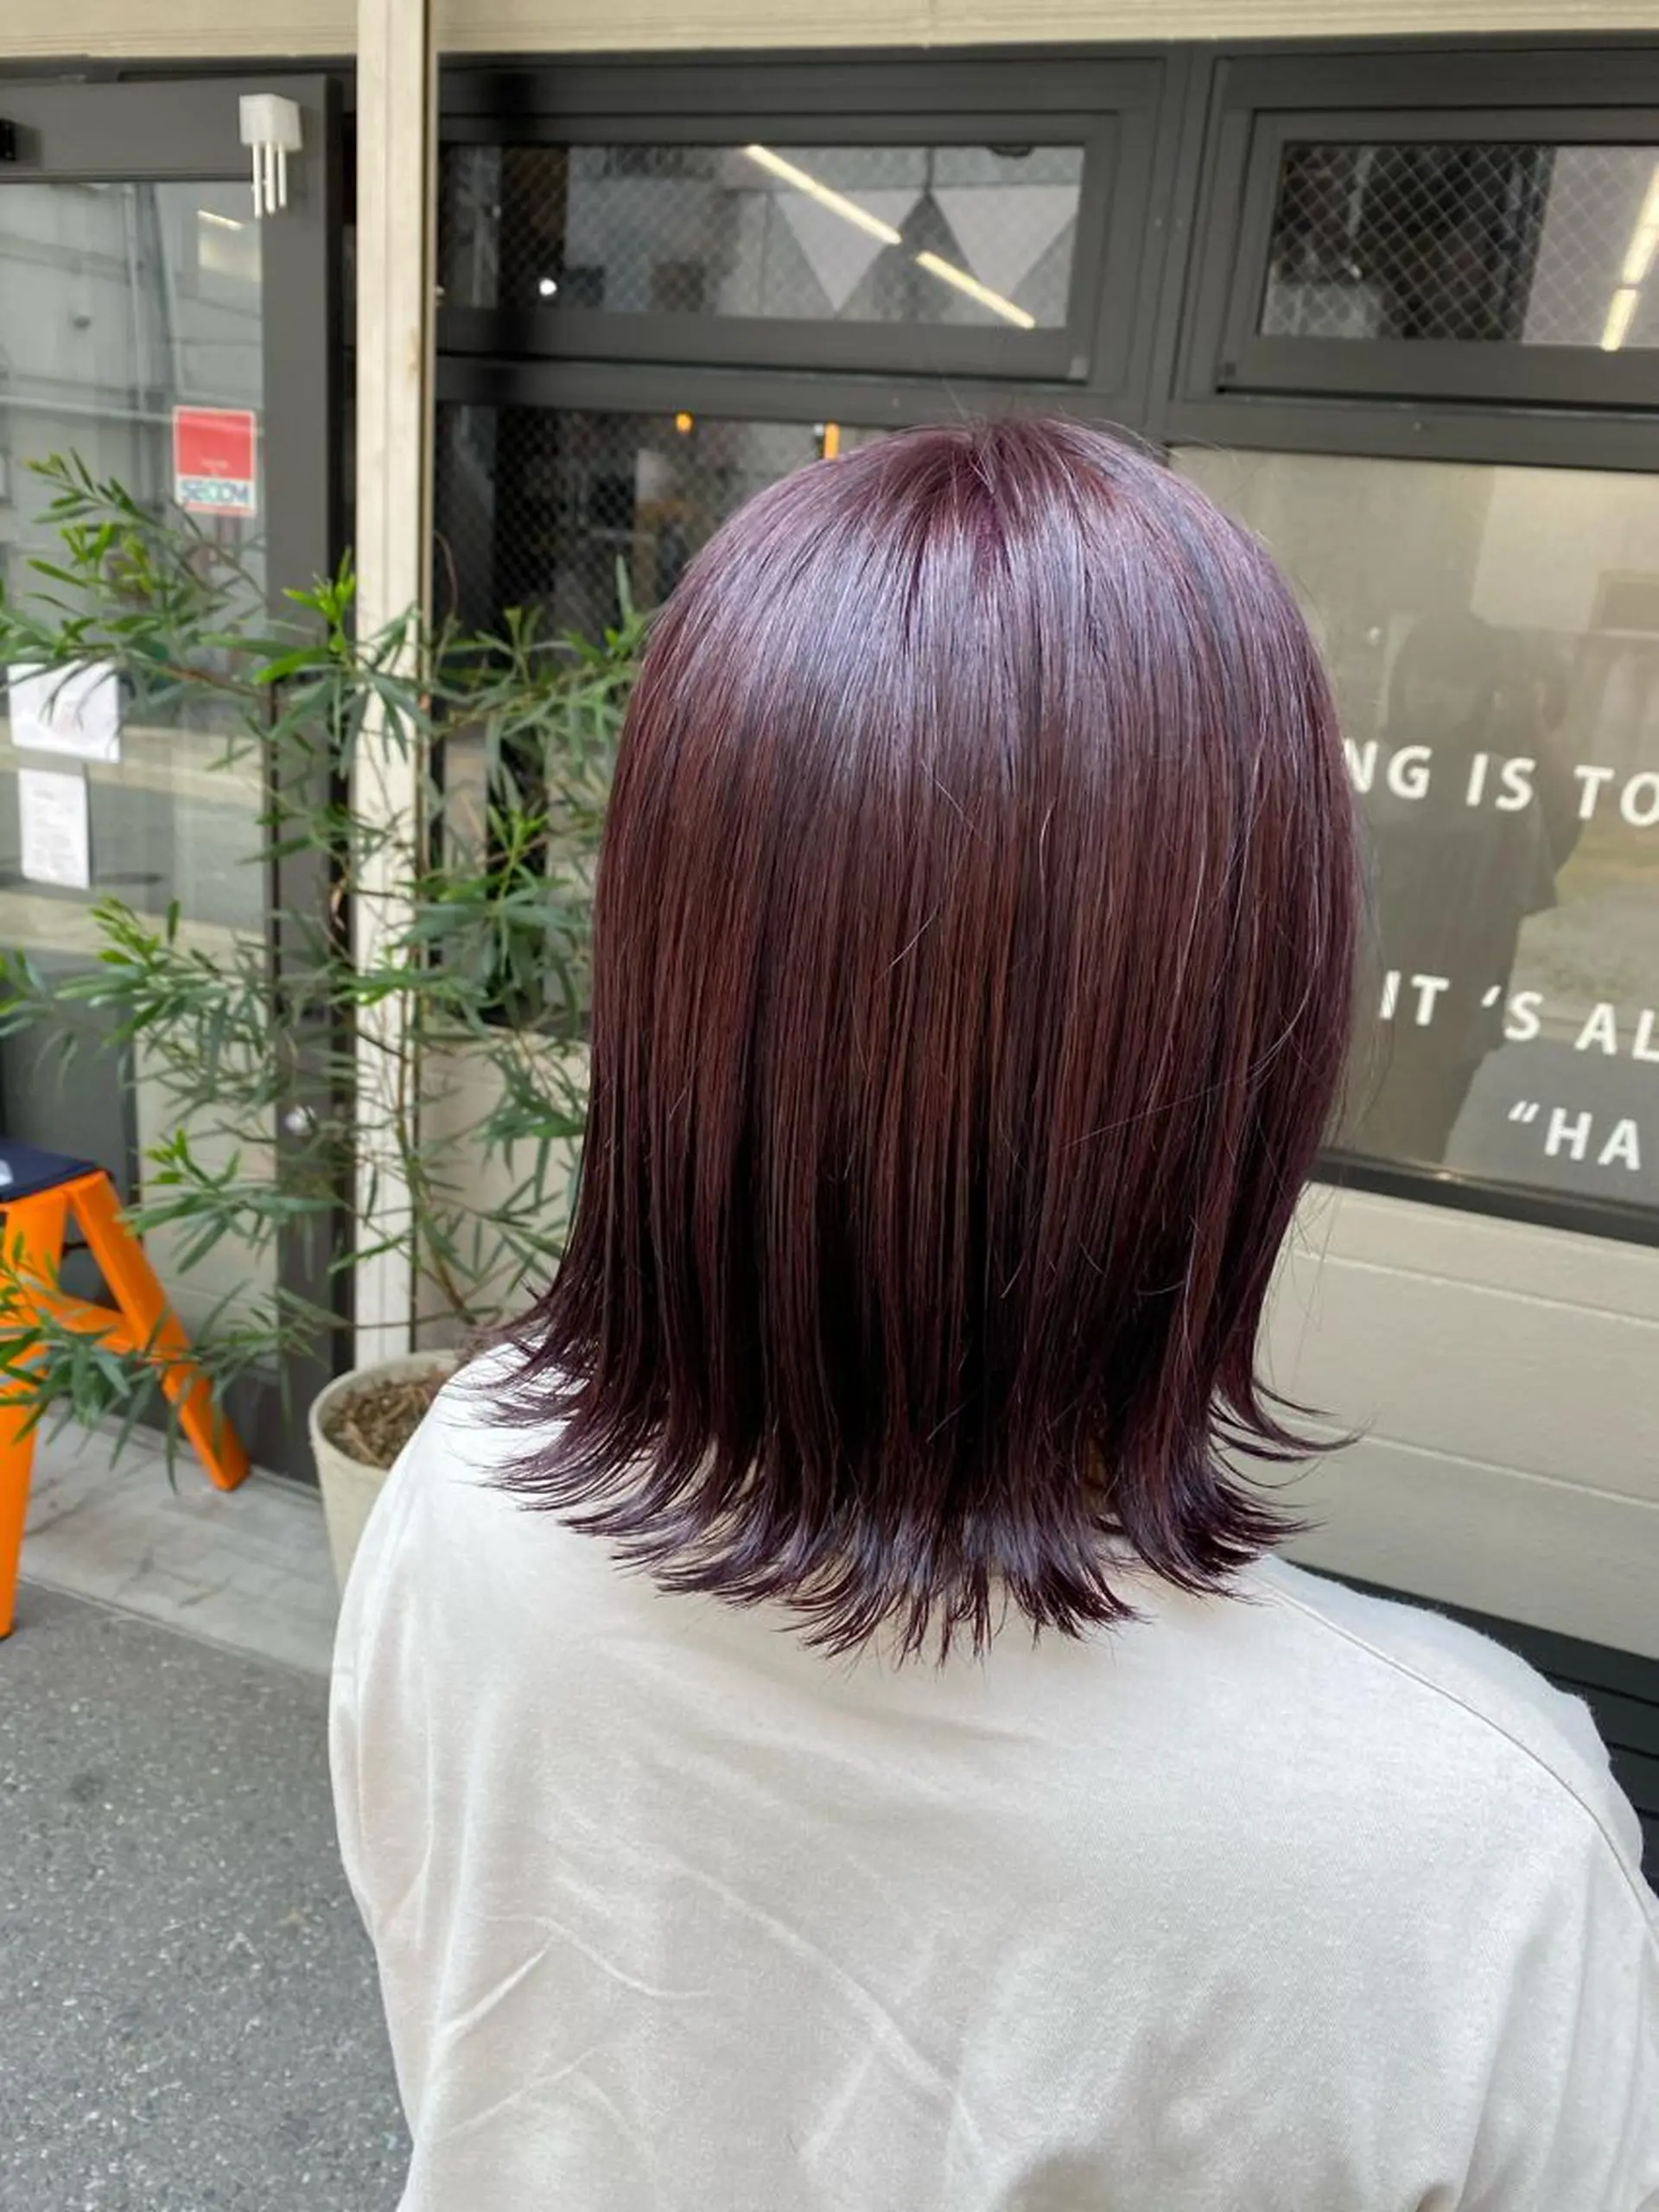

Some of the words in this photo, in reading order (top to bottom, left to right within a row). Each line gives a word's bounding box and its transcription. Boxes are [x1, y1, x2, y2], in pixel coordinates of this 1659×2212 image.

[1465, 752, 1536, 812] IS
[1573, 764, 1659, 827] TO
[1379, 969, 1450, 1027] IT
[1573, 1002, 1659, 1063] AL
